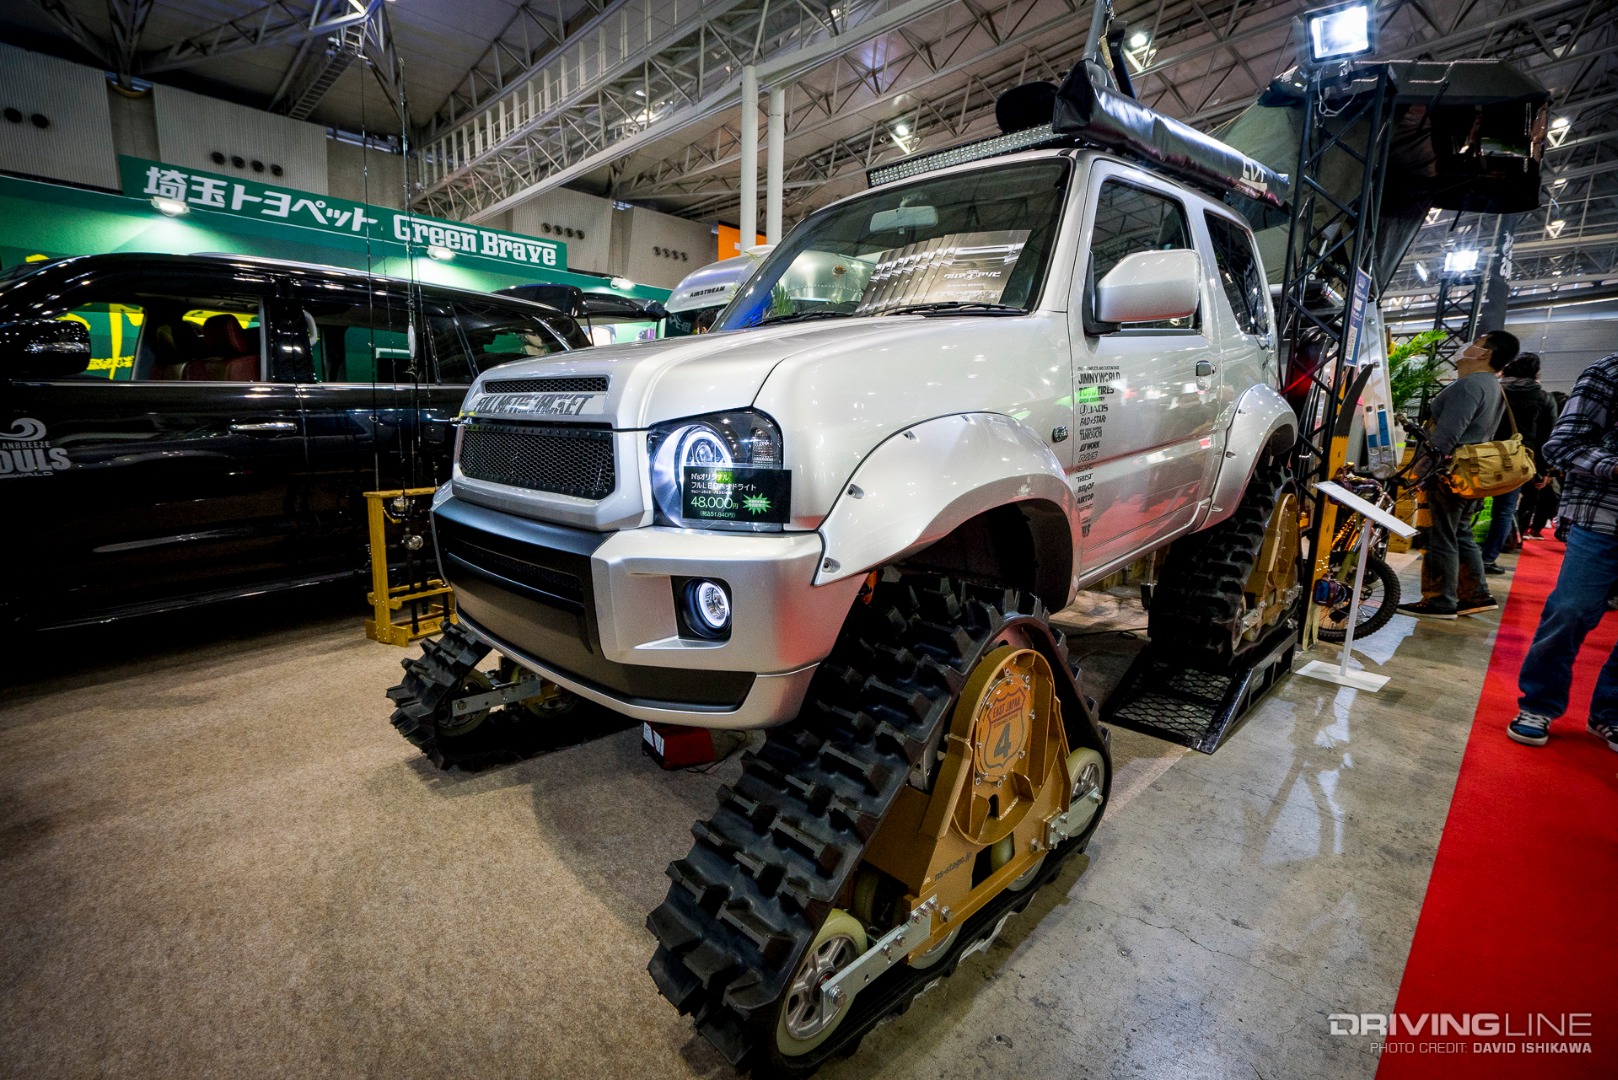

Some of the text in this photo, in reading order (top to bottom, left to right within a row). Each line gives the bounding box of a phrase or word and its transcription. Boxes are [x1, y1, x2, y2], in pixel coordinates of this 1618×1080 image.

[143, 166, 378, 232] 埼玉トヨペット
[393, 214, 557, 266] Green Brave
[690, 286, 726, 298] AIRSTREAM
[0, 441, 51, 450] ANBREEZE
[1075, 473, 1094, 483] TRUST
[690, 495, 739, 510] 48,000円
[993, 702, 1006, 719] EAST
[993, 722, 1012, 759] 4
